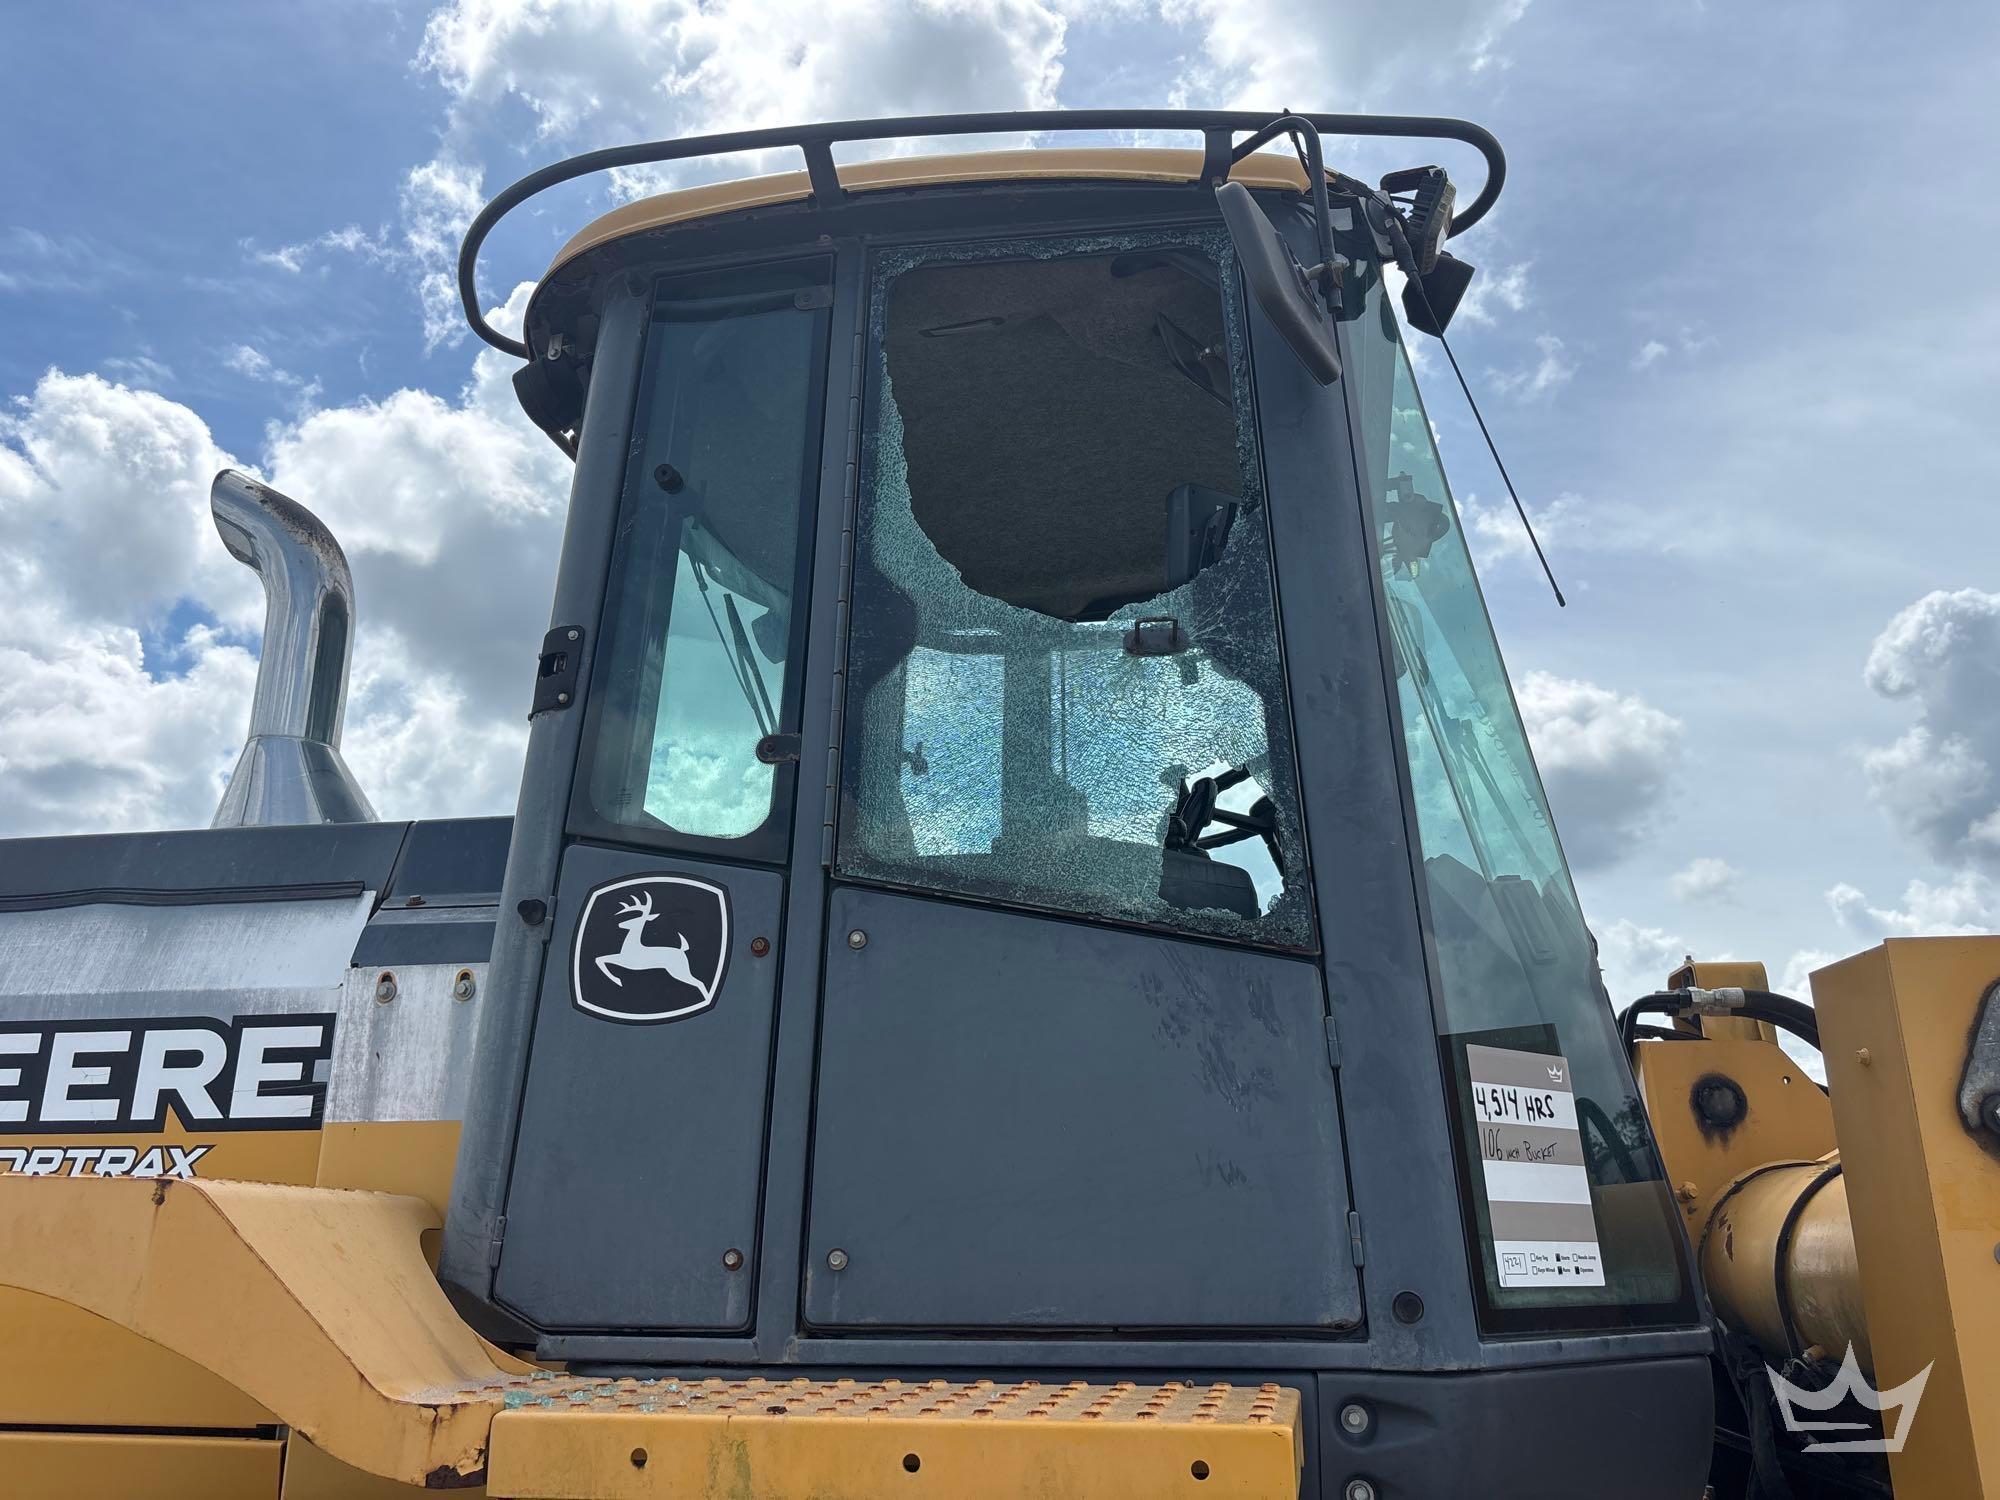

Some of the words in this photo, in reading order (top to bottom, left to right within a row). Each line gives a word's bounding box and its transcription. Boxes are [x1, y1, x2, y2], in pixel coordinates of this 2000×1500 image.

[1475, 1086, 1520, 1122] 4,514
[1525, 1093, 1555, 1123] HRS
[1483, 1127, 1503, 1161] 106
